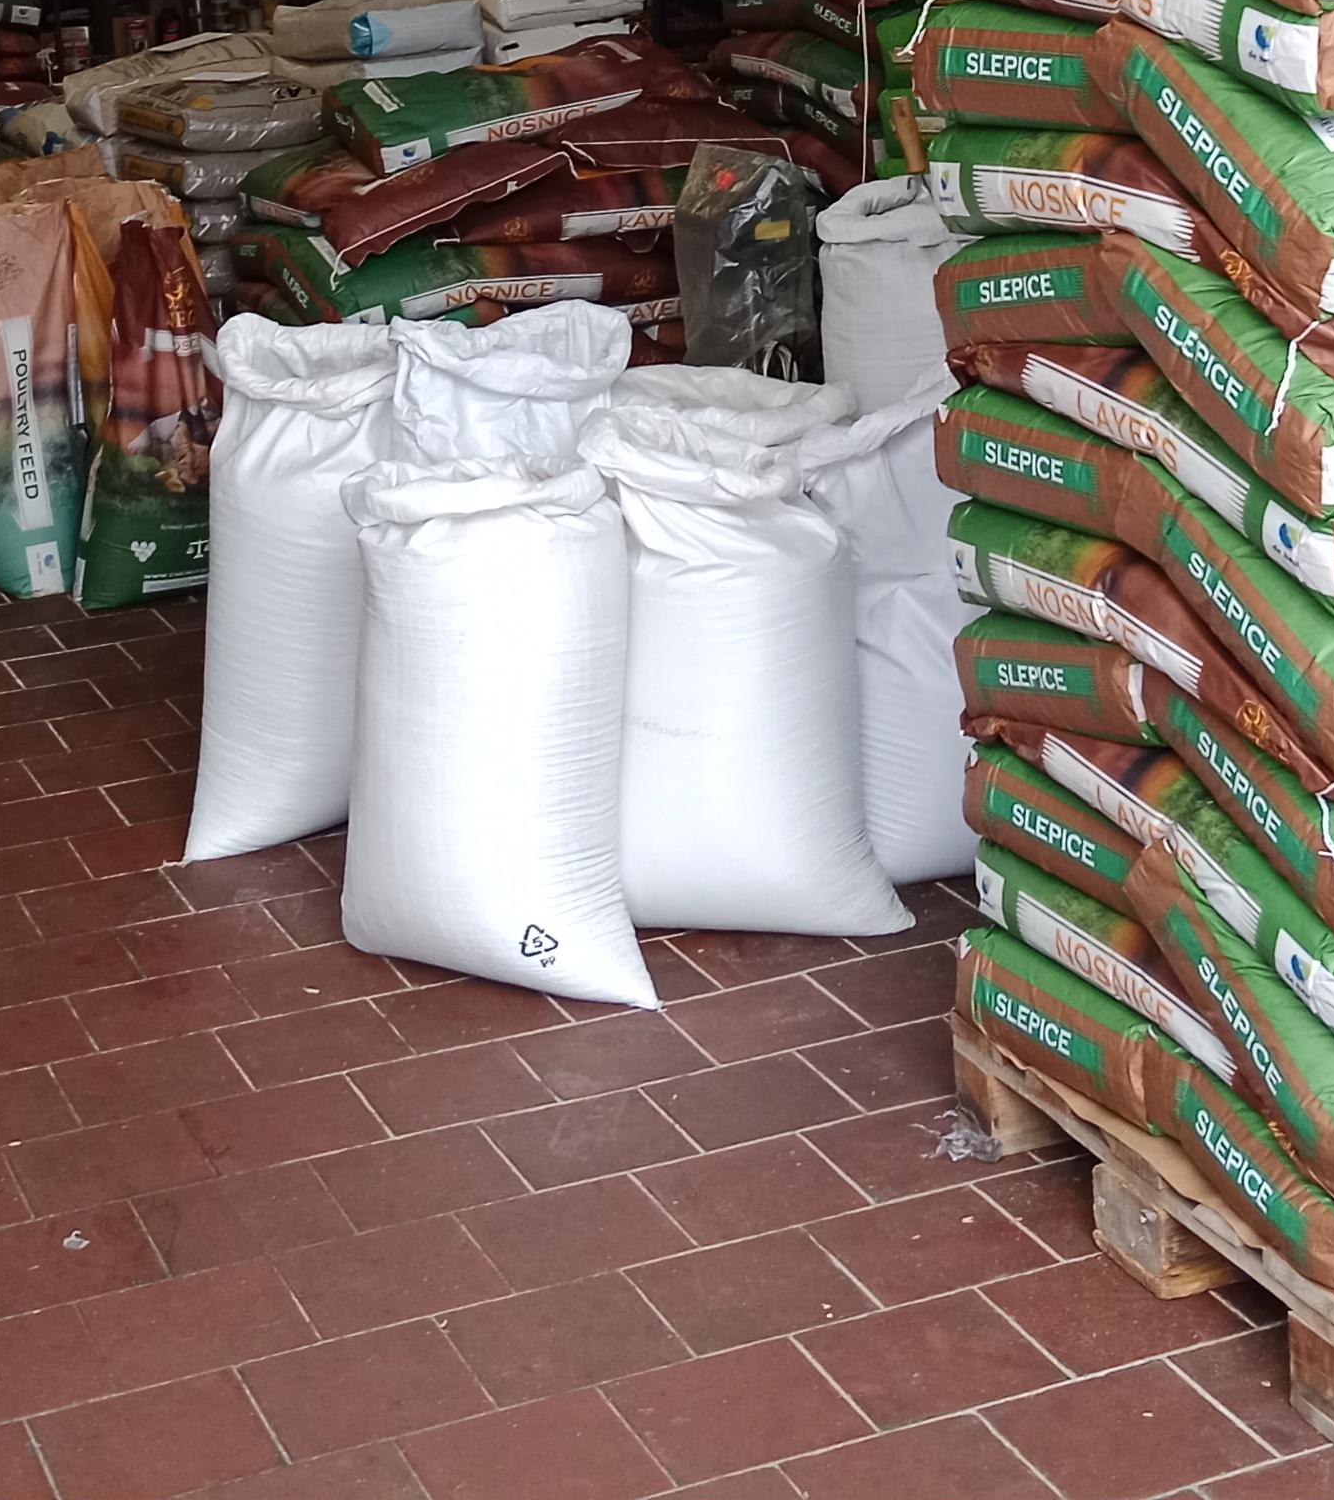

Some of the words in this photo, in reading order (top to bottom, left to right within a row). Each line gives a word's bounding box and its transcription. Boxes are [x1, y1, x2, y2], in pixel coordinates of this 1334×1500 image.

[813, 2, 854, 34] SLEPICE
[965, 51, 1053, 82] SLEPICE
[487, 104, 600, 142] NOSNICE
[1156, 85, 1250, 206] SLEPICE
[1008, 178, 1128, 230] NOSNICE
[444, 281, 556, 307] NOSNICE
[978, 272, 1055, 304] SLEPICE
[1154, 308, 1245, 409] SLEPICE
[12, 349, 31, 438] POULTRY
[983, 441, 1065, 484] SLEPICE
[1076, 389, 1178, 474] LAYERS
[18, 442, 39, 500] FEED
[1024, 578, 1138, 650] NOSNICE
[1188, 551, 1281, 674] SLEPICE
[997, 663, 1068, 693] SLEPICE
[1197, 730, 1281, 843] SLEPICE
[1012, 804, 1096, 867] SLEPICE
[1094, 784, 1198, 879] LAYERS
[532, 936, 543, 949] 5
[539, 956, 557, 969] PP
[1054, 927, 1175, 1026] NOSNICE
[995, 992, 1073, 1057] SLEPICE
[1197, 955, 1286, 1097] SLEPICE
[1194, 1110, 1275, 1212] SLEPICE
